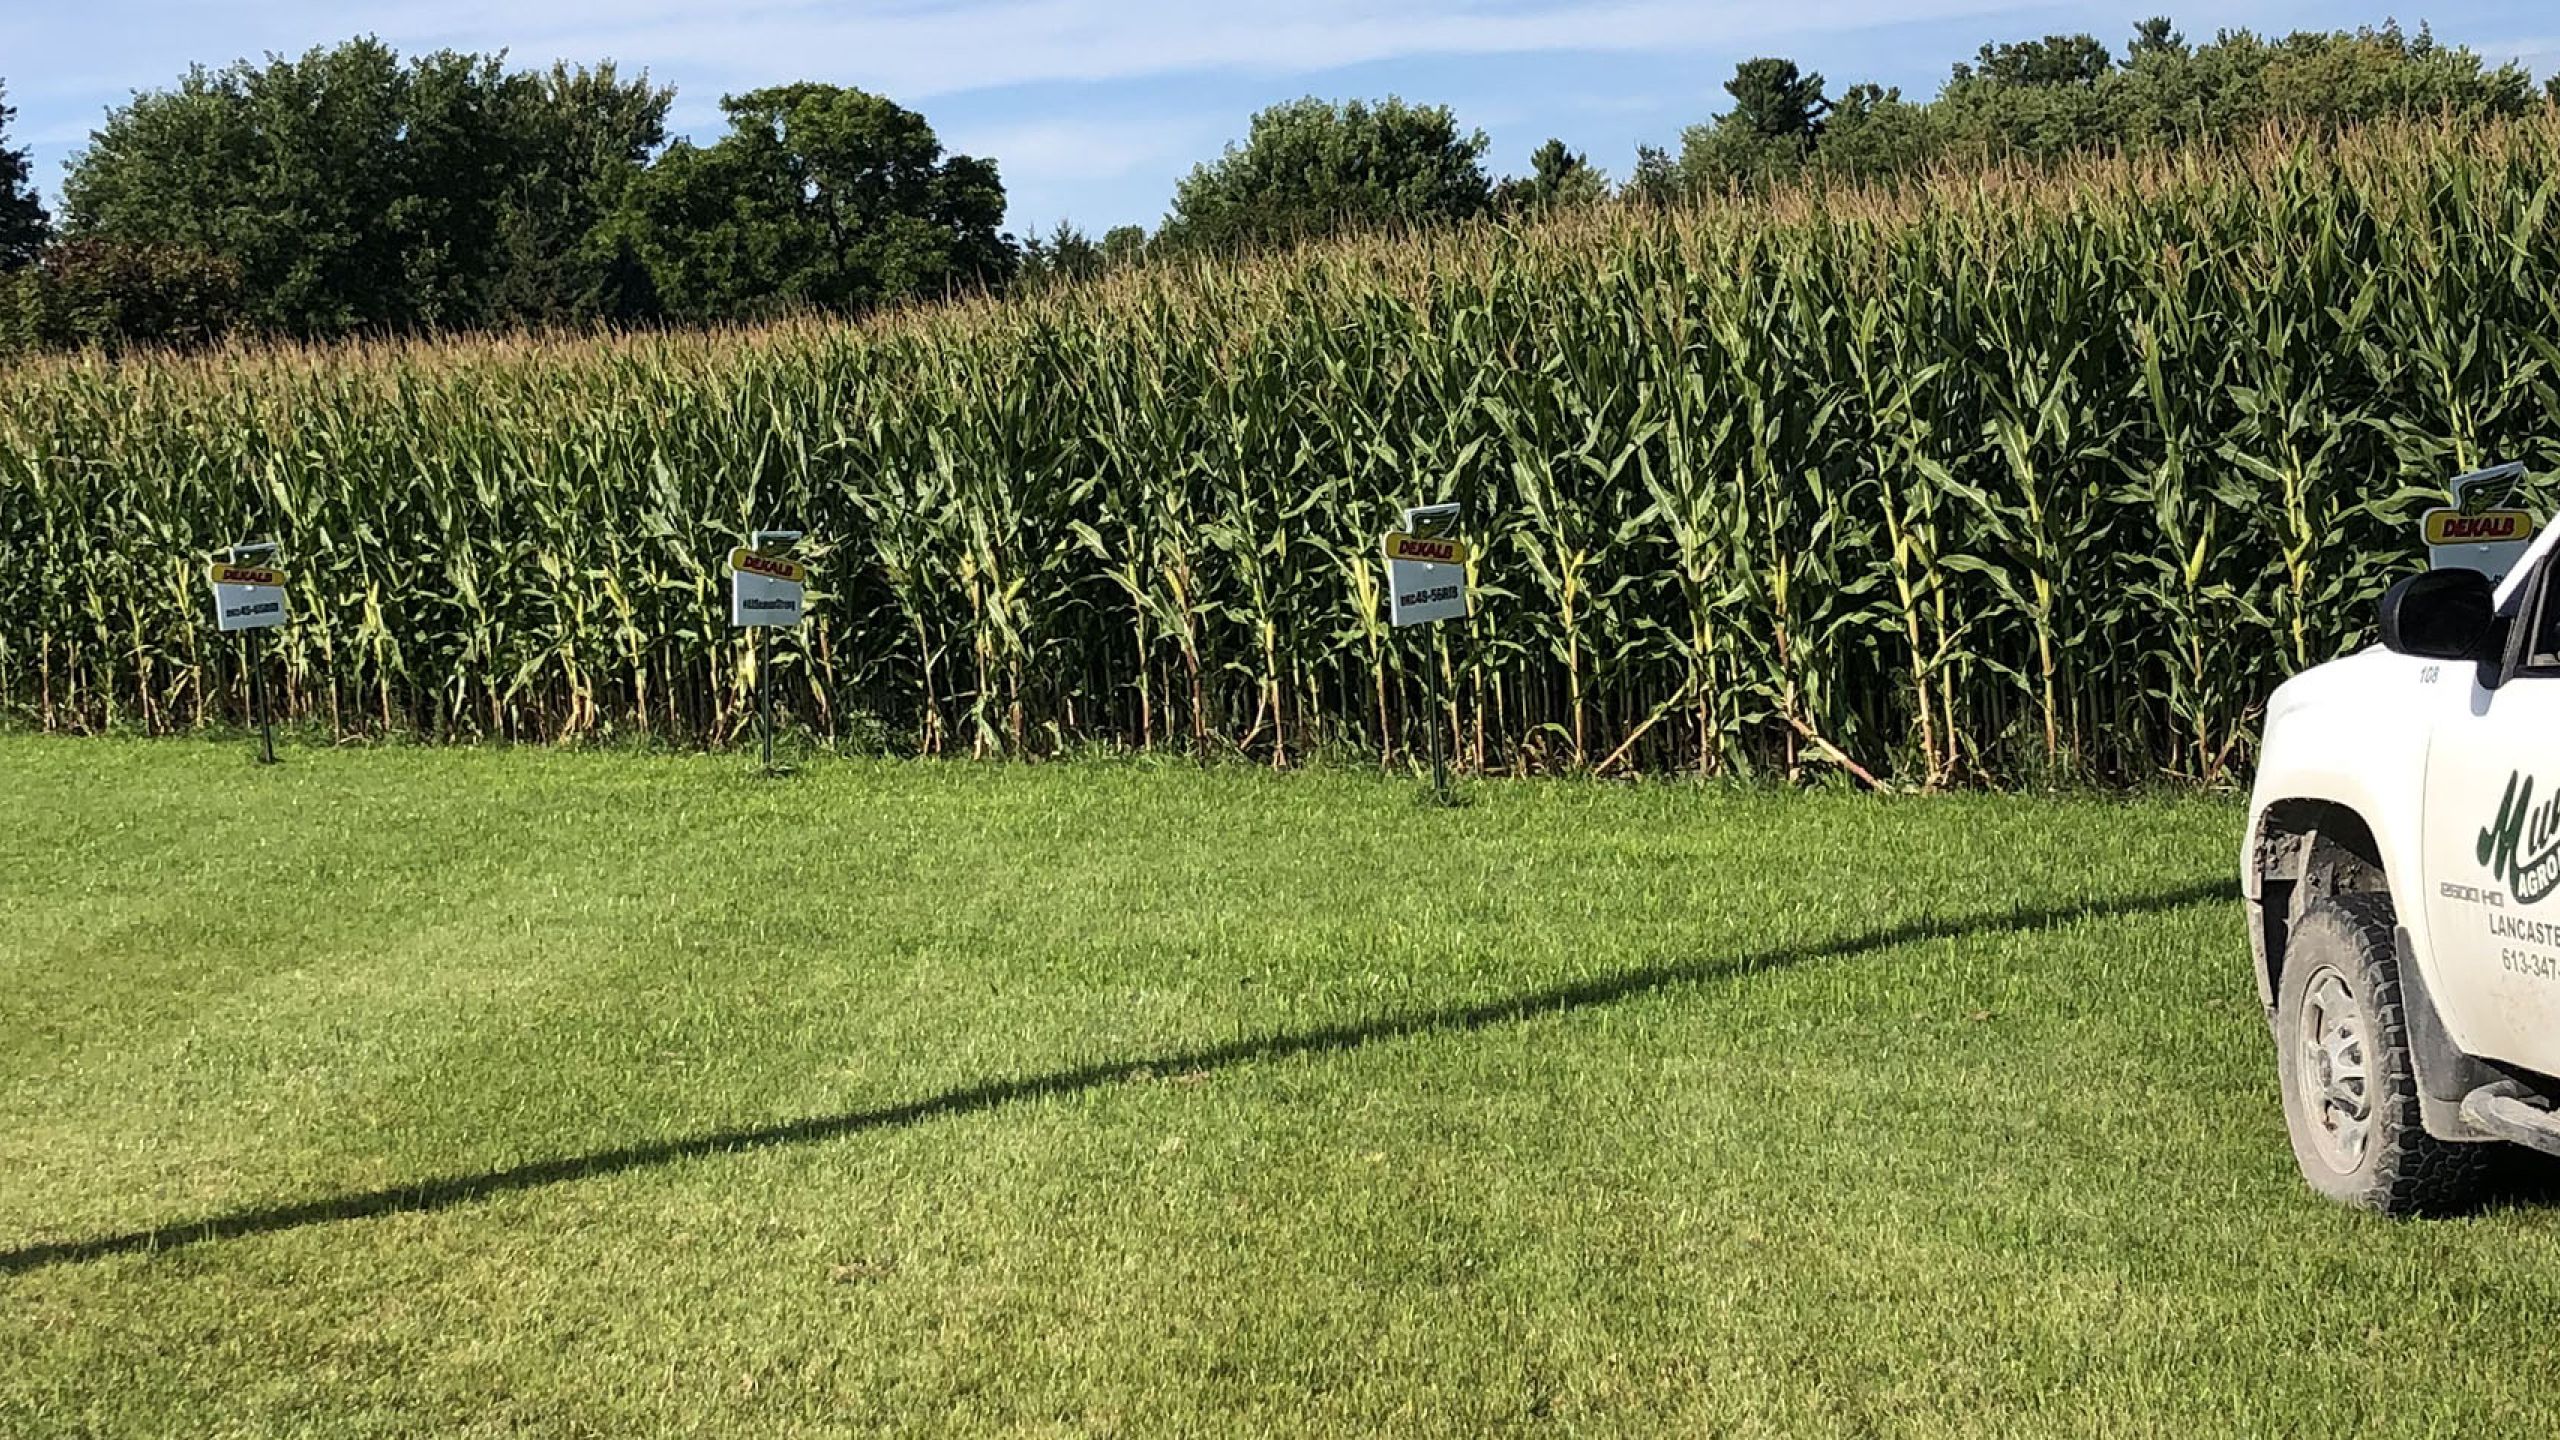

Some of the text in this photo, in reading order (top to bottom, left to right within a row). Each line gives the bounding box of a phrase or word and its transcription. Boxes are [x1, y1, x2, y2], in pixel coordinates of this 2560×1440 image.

[2442, 517, 2515, 537] DEKALB
[1399, 540, 1453, 559] DEKALB
[743, 556, 794, 576] DEKALB
[223, 570, 273, 582] DEKALB
[2482, 889, 2504, 907] HD
